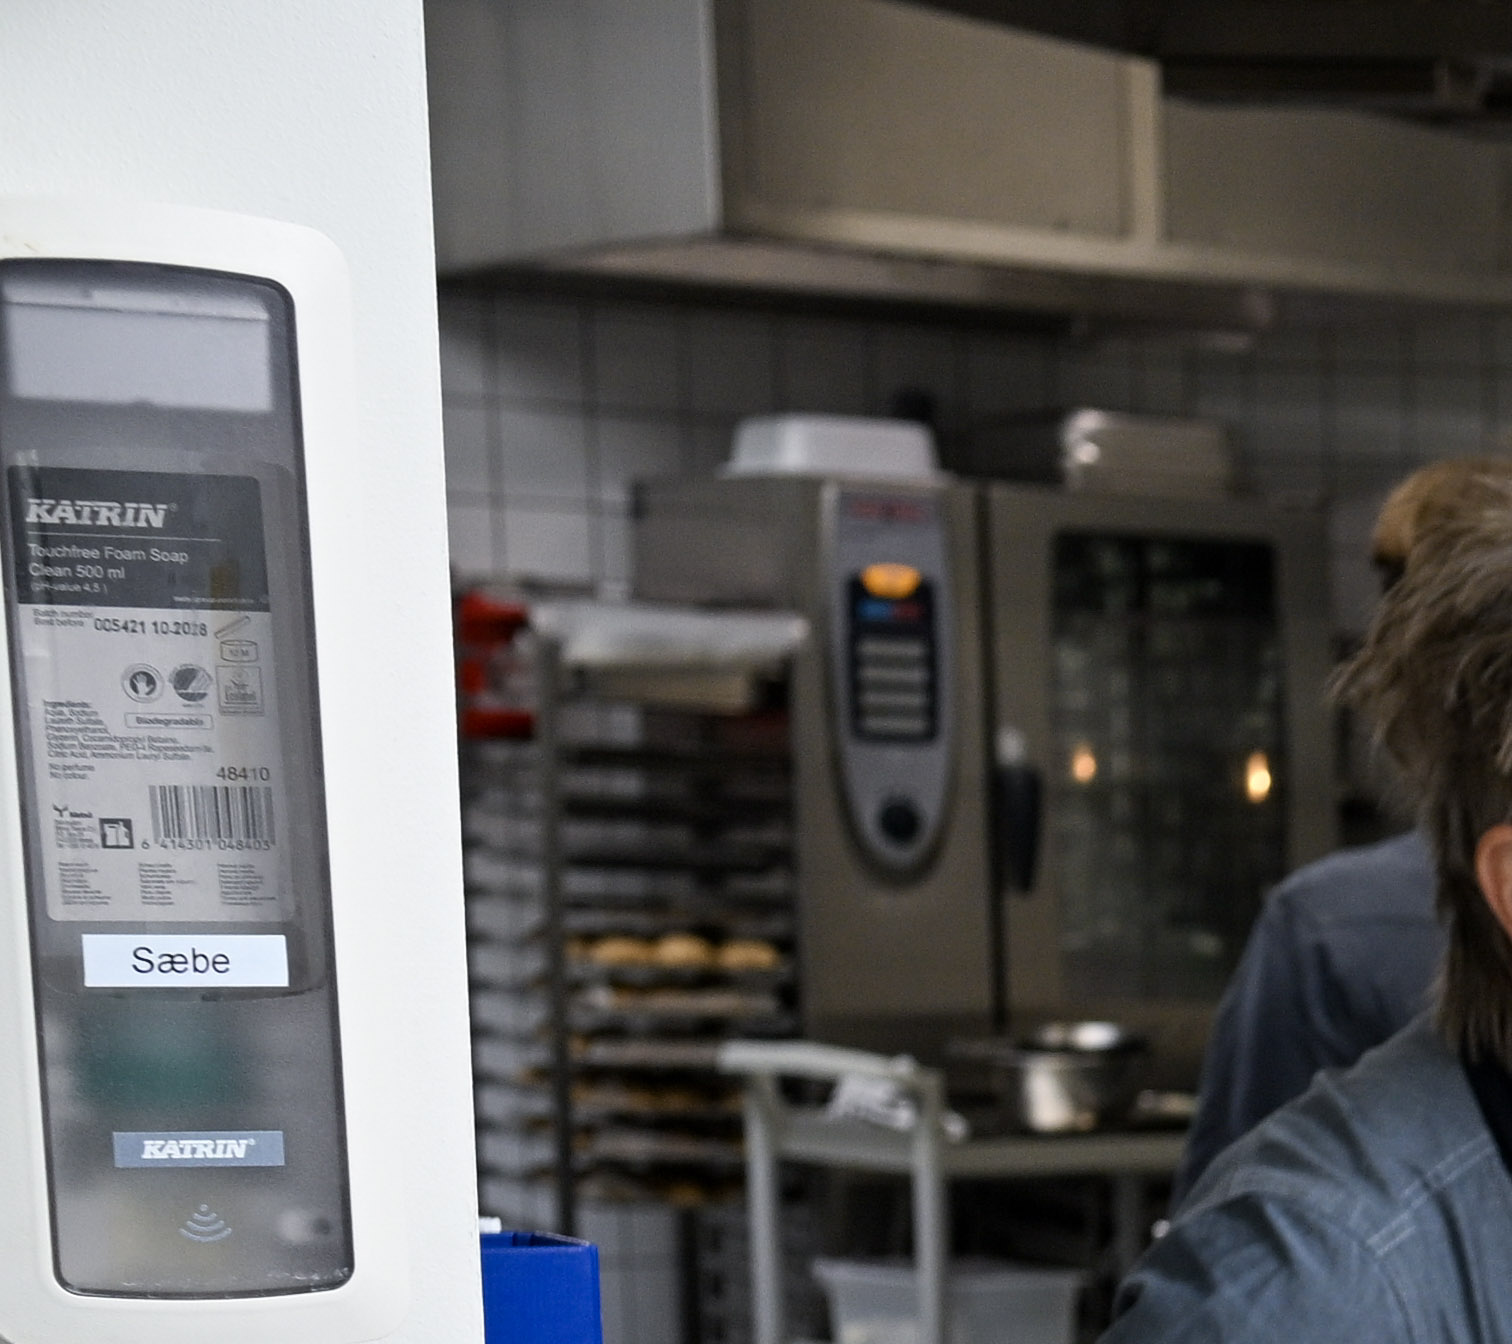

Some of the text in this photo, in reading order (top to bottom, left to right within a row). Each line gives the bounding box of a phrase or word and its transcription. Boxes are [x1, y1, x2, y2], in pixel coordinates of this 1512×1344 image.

[27, 543, 189, 566] Touchfree Foam Soap
[28, 562, 126, 580] Clean 500 ml
[94, 618, 147, 635] 005421
[216, 766, 271, 782] 48410
[141, 840, 150, 850] 6
[132, 946, 231, 974] Sæbe
